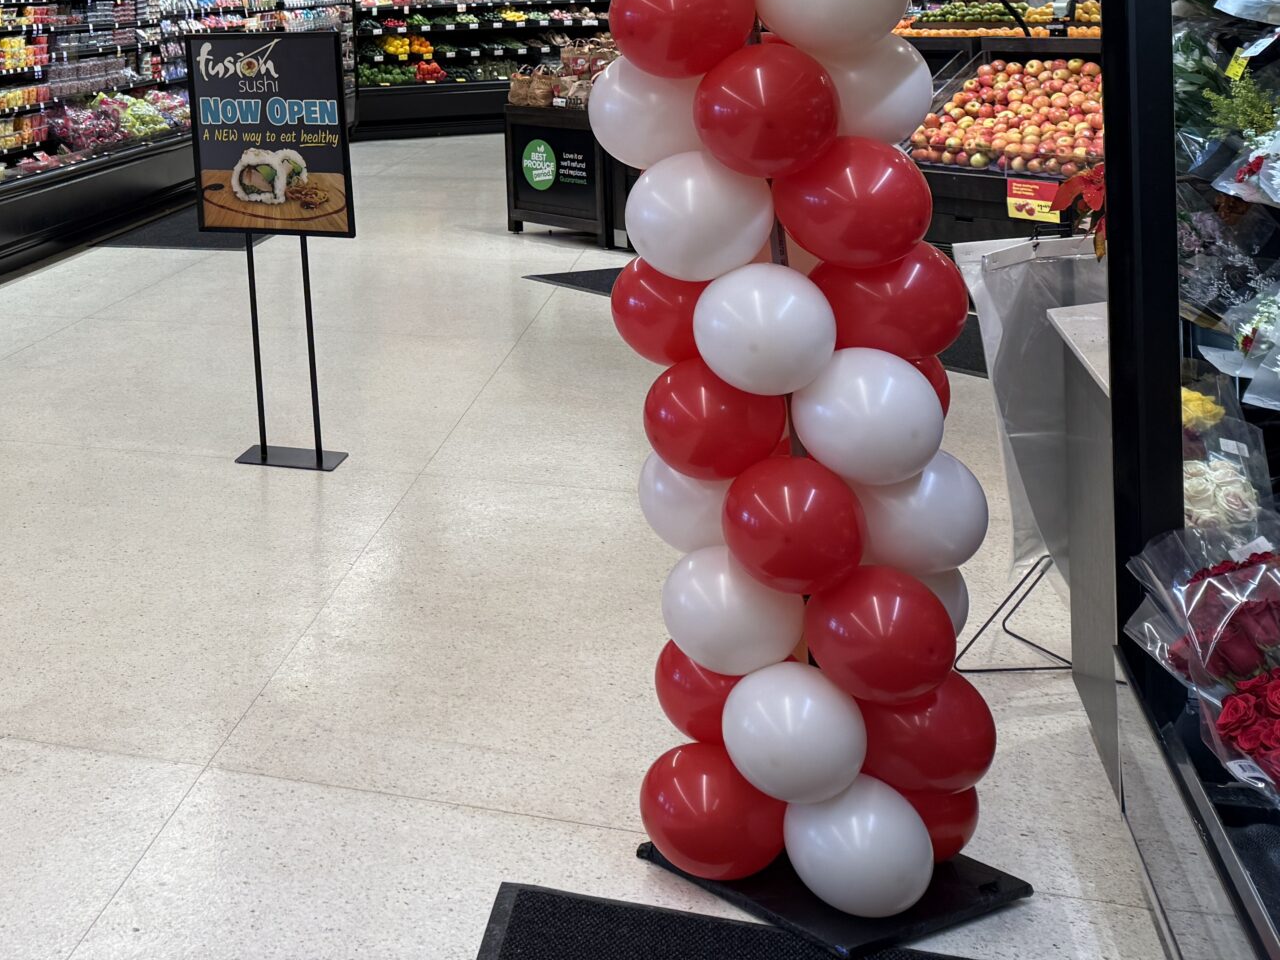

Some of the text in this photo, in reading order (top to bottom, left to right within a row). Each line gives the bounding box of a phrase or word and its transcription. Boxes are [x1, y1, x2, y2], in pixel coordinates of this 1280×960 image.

[238, 75, 279, 93] sushi
[199, 97, 339, 126] NOW OPEN
[203, 129, 339, 148] A NEW way to eat healthy
[523, 159, 555, 171] PRODUCE
[530, 152, 546, 161] BEST
